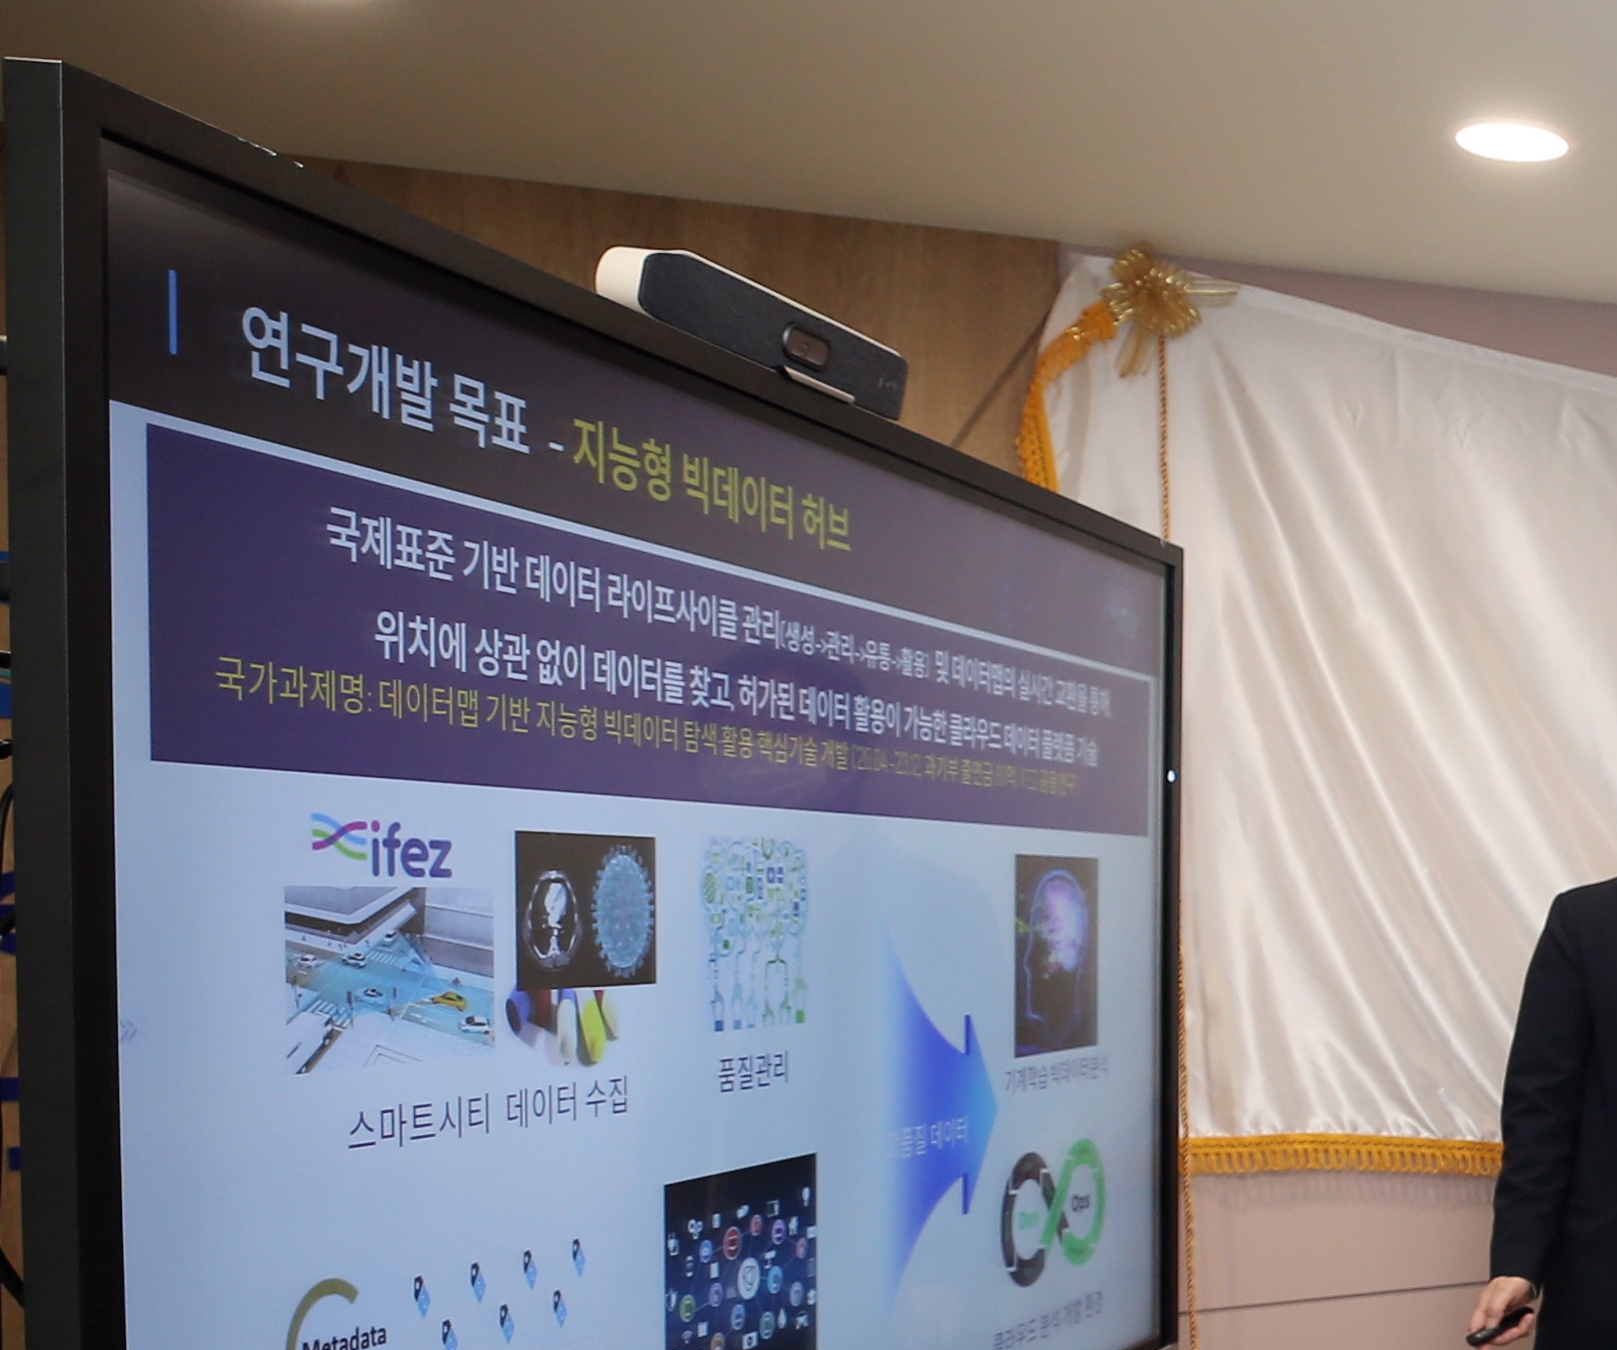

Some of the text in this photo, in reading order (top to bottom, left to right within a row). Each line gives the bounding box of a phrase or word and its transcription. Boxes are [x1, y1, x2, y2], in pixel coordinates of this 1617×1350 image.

[242, 306, 439, 432] 연구개발
[450, 373, 531, 454] 목표
[573, 417, 673, 502] 지능형
[682, 453, 794, 540] 빅데이터
[801, 492, 851, 551] 허브
[326, 506, 456, 581] 국제표준
[463, 540, 520, 594] 기반
[525, 554, 601, 613] 데이터
[607, 573, 739, 641] 라이프사이클
[935, 650, 949, 685] 및
[215, 655, 373, 716] 국가과제명:
[378, 678, 480, 729] 데이터맵
[486, 693, 531, 734] 기반
[536, 699, 599, 742] 지능형
[603, 709, 680, 752] 빅데이터
[757, 729, 819, 768] 핵심기술
[820, 735, 848, 771] 개발
[375, 610, 467, 673] 위치에
[474, 628, 531, 681] 상관
[536, 639, 586, 690] 없이
[593, 650, 686, 705] 데이터를
[689, 666, 735, 711] 찾고,
[737, 673, 796, 722] 허가된
[798, 686, 851, 731] 데이터
[853, 694, 901, 738] 활용이
[904, 704, 948, 745] 가능한
[949, 712, 1002, 751] 클라우드
[1003, 723, 1040, 757] 데이터
[369, 820, 453, 879] ifez
[347, 1074, 630, 1150] 스마트시티 데이터 수집
[717, 1050, 790, 1095] 품질관리
[929, 1114, 968, 1149] 데이터
